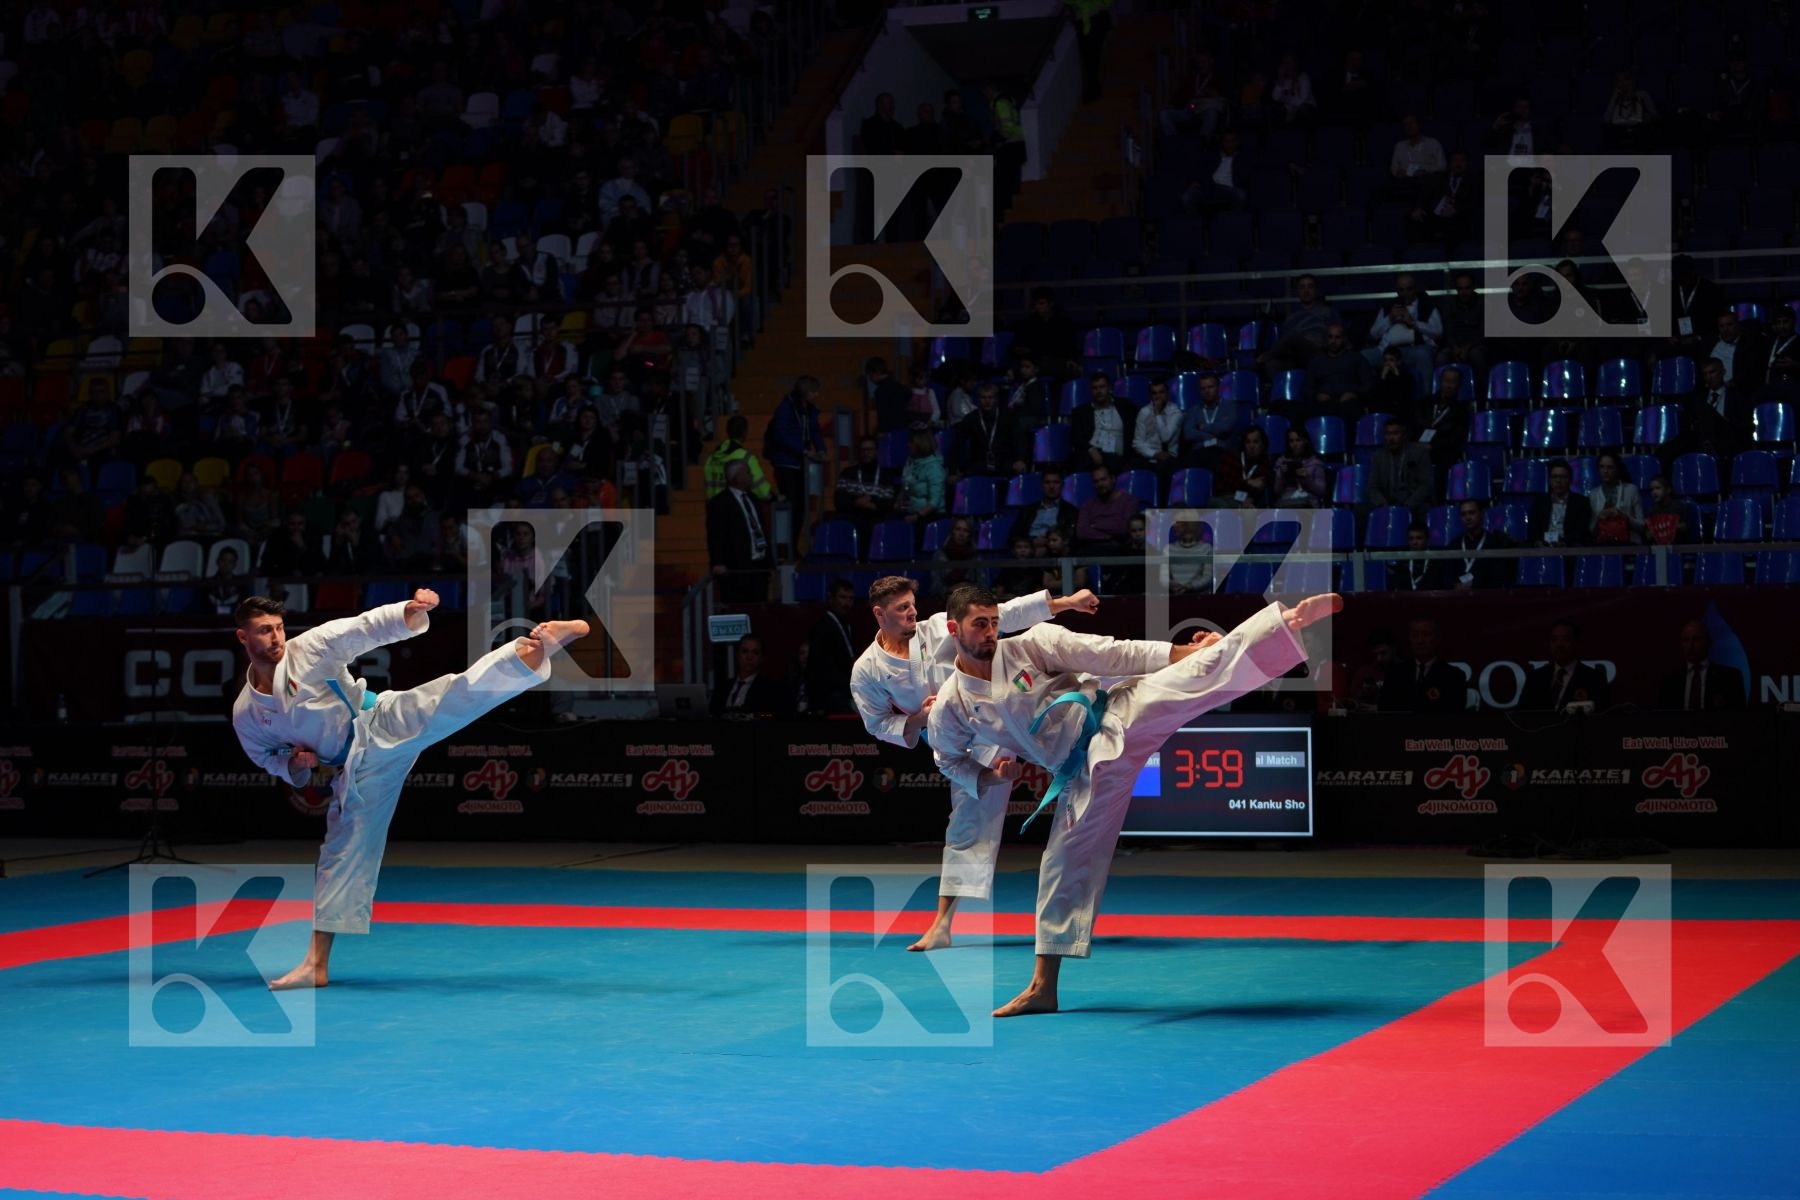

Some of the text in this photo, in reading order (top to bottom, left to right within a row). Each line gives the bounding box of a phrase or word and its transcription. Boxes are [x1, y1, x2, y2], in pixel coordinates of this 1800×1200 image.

[1405, 739, 1424, 751] Eat
[1454, 739, 1478, 751] Live
[1622, 737, 1642, 750] Eat
[1673, 737, 1697, 750] Live
[1266, 755, 1297, 765] Match
[1175, 749, 1243, 789] 3:59
[1229, 799, 1305, 810] 041 Kanku Sho
